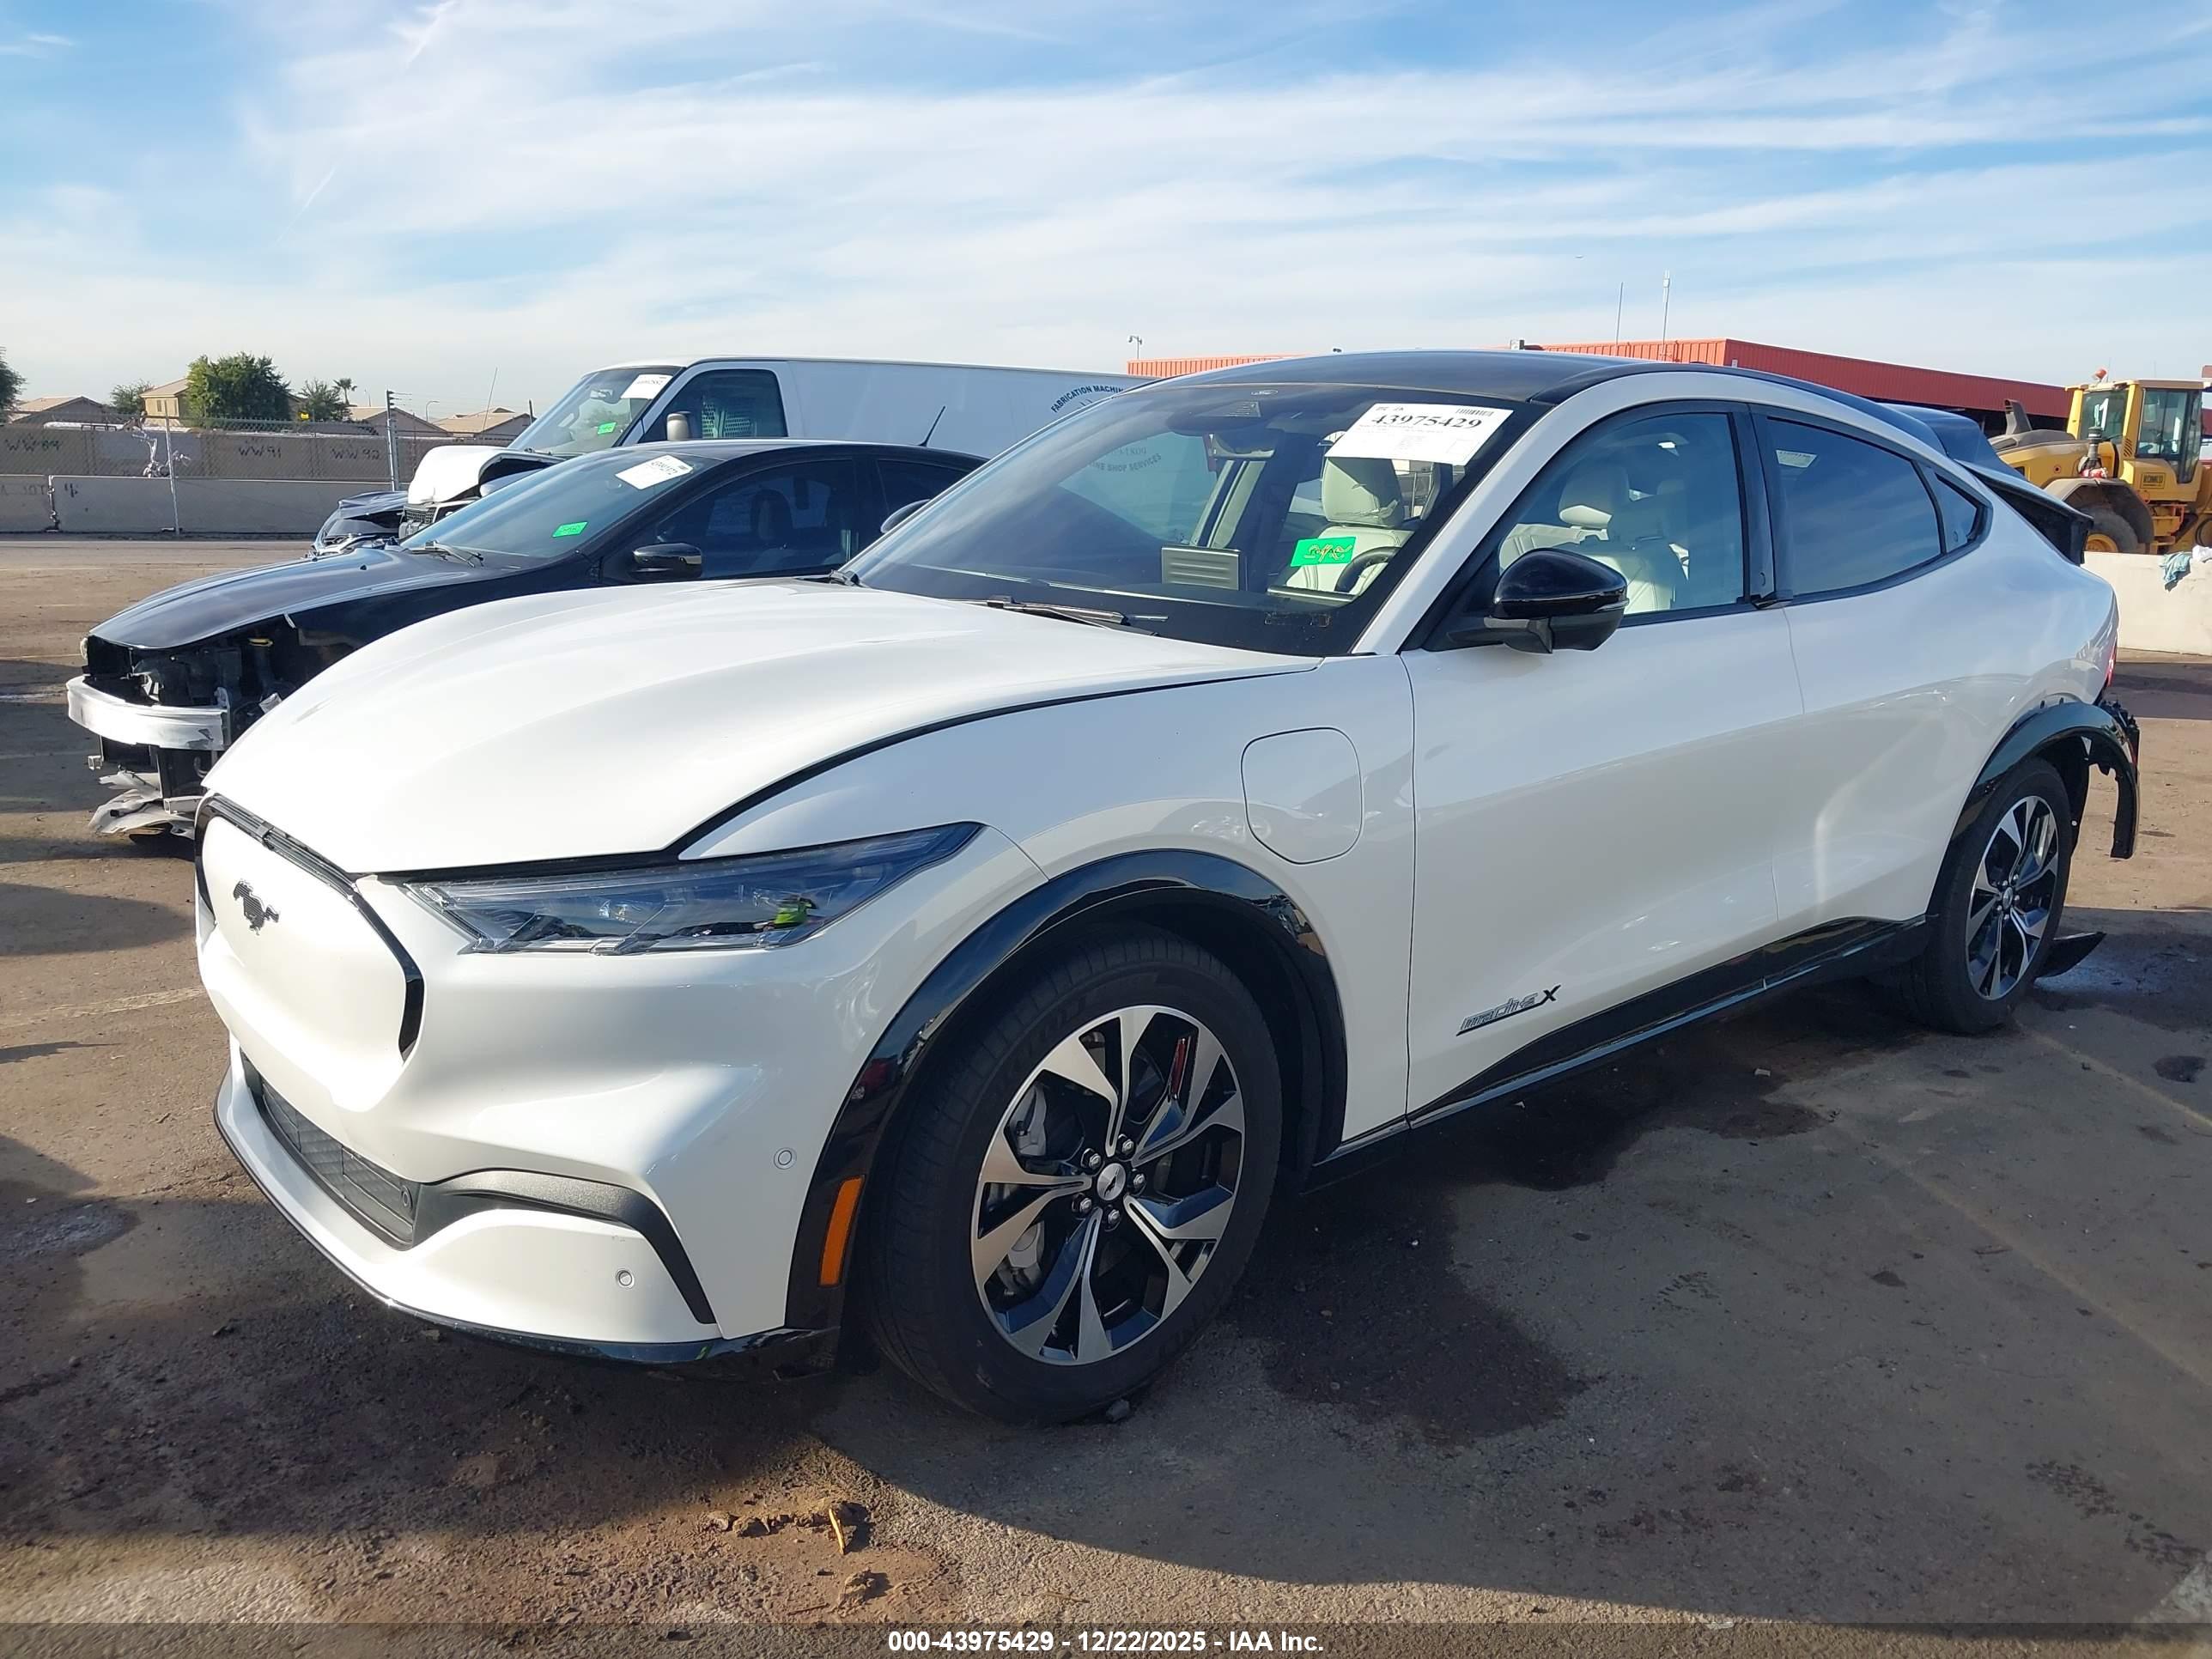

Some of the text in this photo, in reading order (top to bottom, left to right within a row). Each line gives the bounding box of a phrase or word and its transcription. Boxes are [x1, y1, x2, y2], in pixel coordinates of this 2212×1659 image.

[1050, 386, 1093, 413] FABRICATION
[1371, 413, 1483, 429] 43975429
[1107, 463, 1127, 472] SHOP
[1129, 453, 1162, 471] SERVICES
